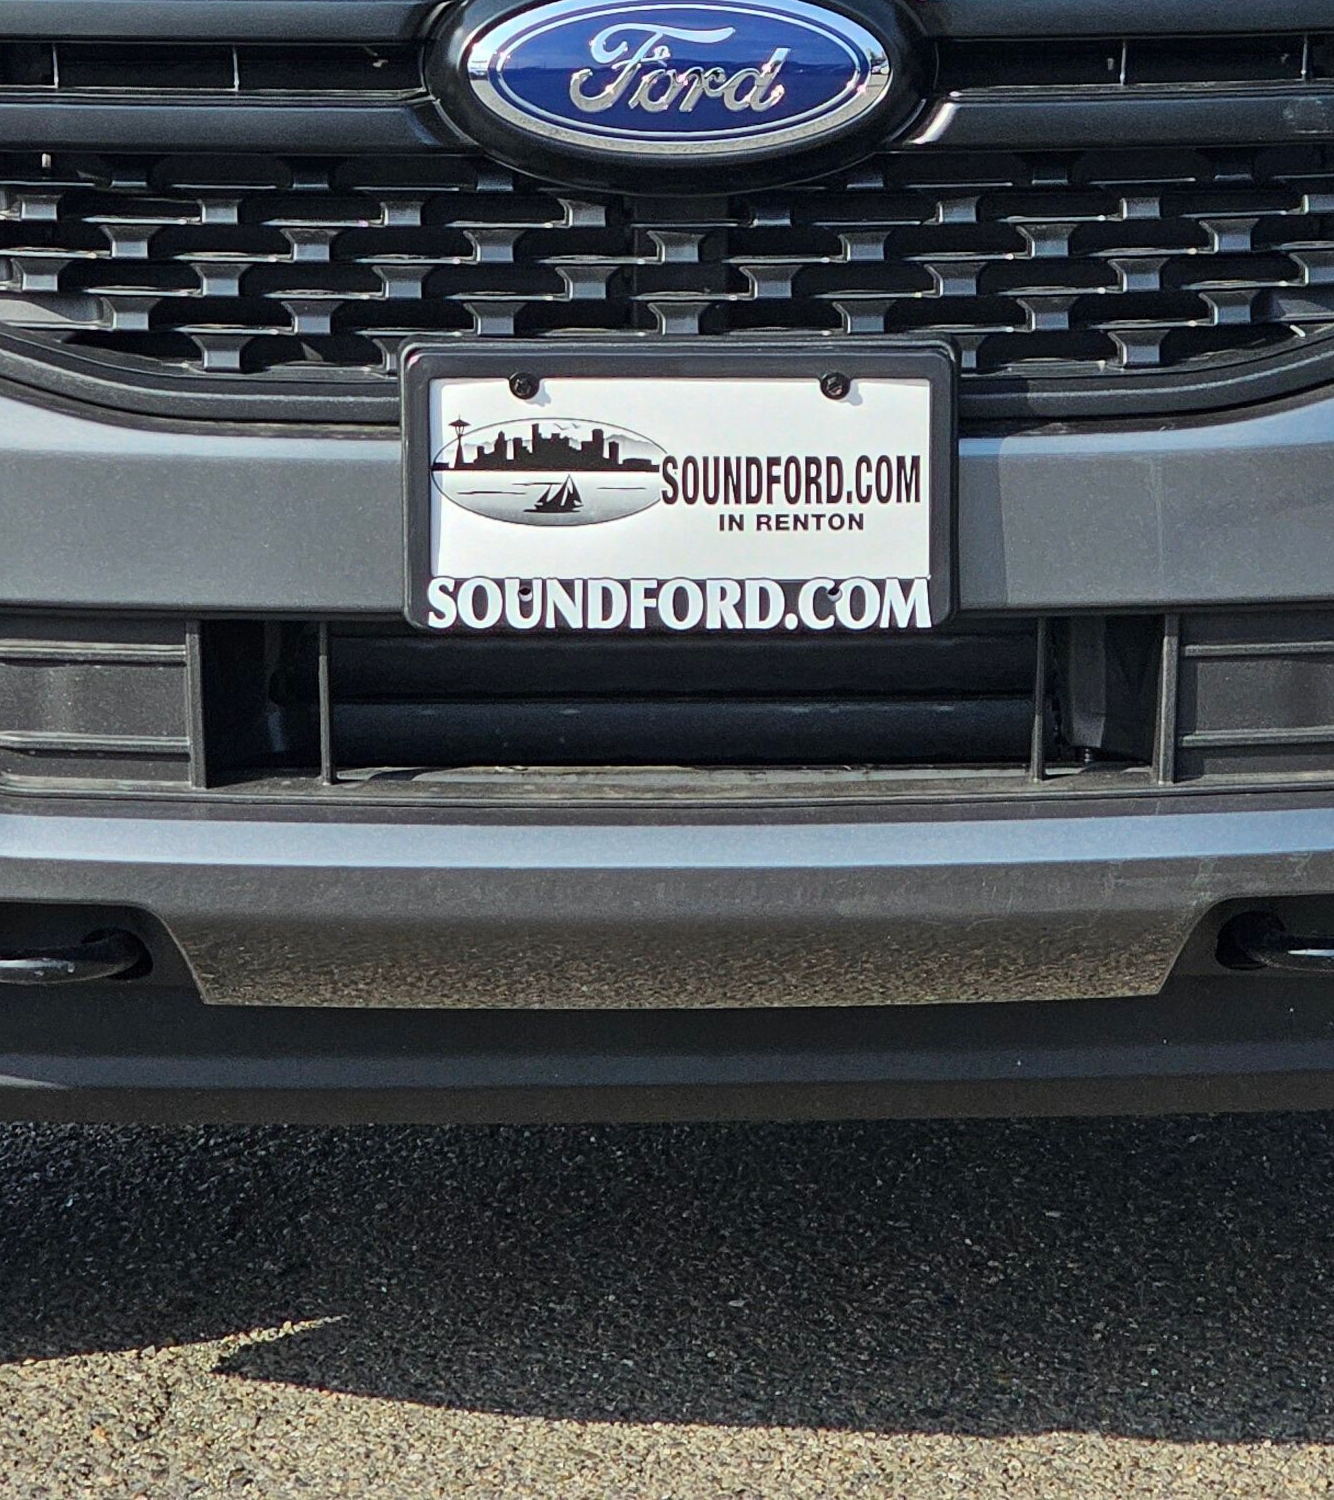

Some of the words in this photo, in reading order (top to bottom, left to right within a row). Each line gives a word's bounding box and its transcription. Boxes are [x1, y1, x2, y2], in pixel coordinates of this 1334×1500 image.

[569, 22, 791, 114] Ford
[660, 455, 922, 505] SOUNDFORD.COM
[718, 513, 746, 532] IN
[756, 512, 865, 532] RENTON
[427, 576, 932, 630] SOUNDFORD.COM
